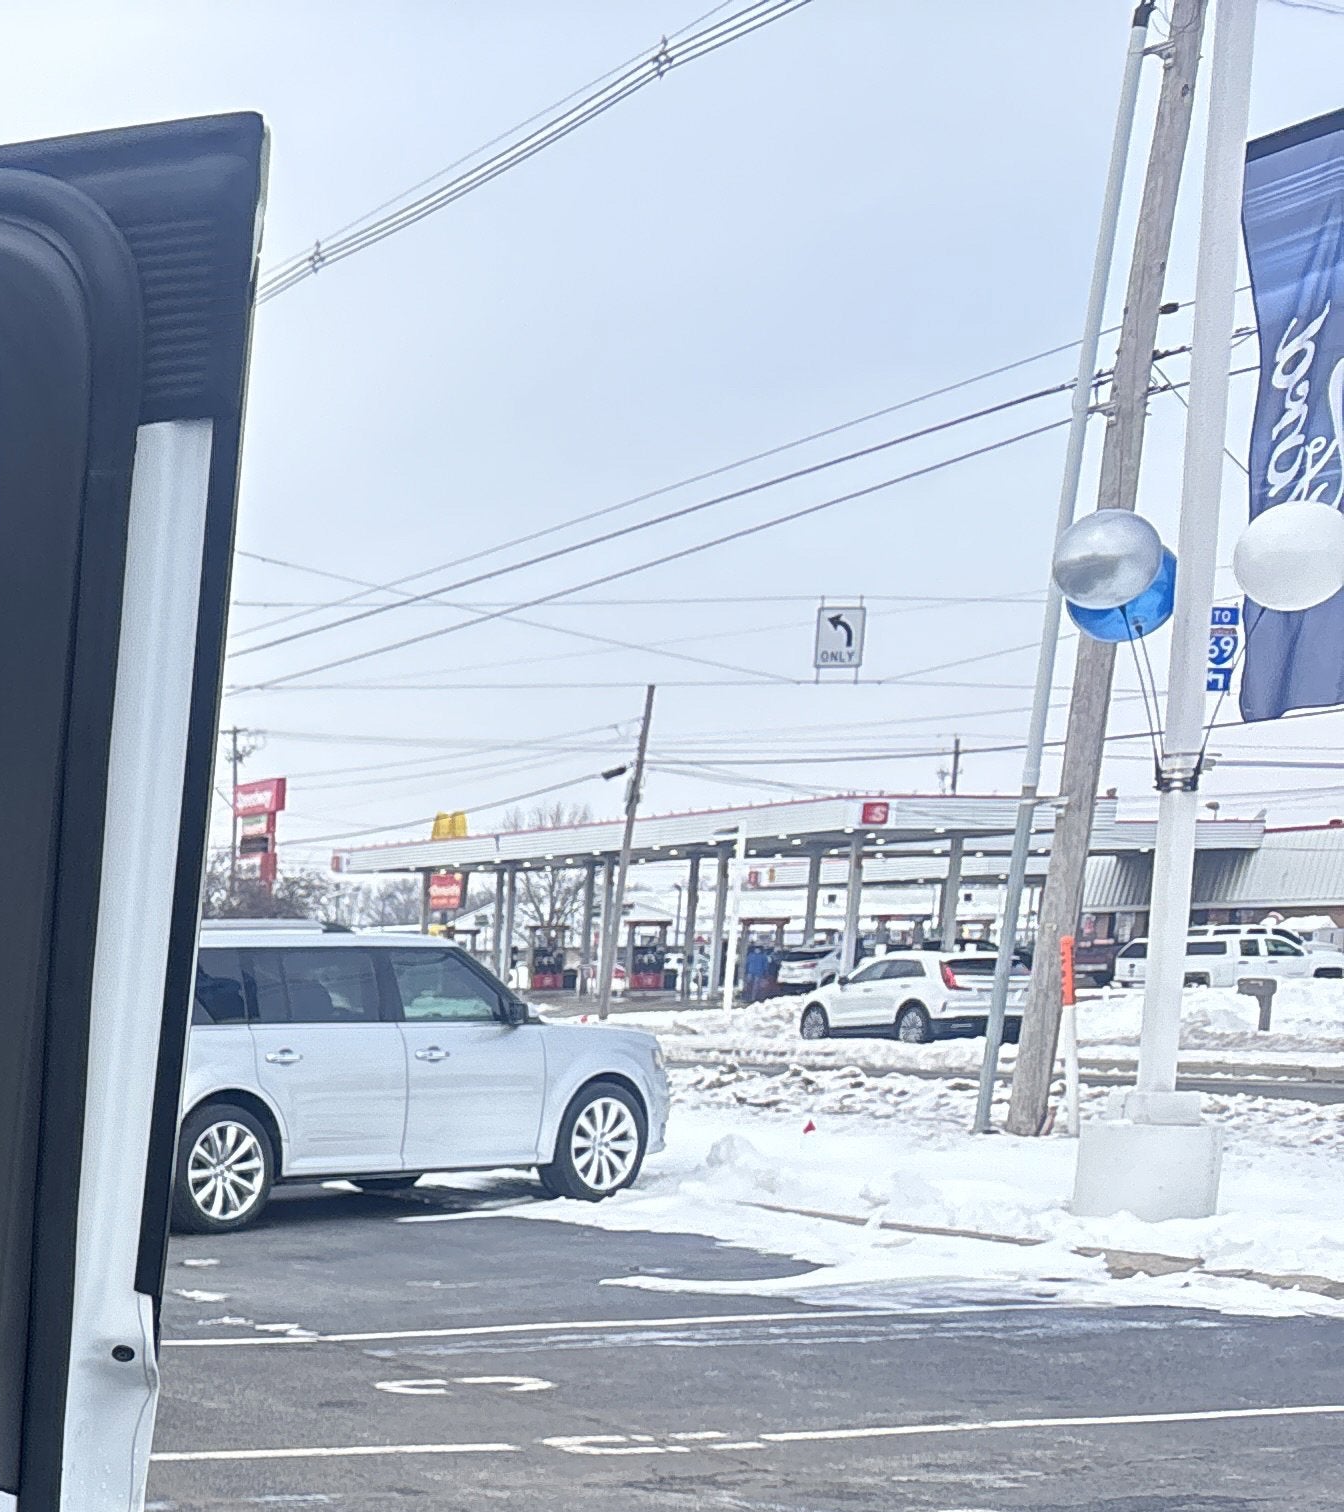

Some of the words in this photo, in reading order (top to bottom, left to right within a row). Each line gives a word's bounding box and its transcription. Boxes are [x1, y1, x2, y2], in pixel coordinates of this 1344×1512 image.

[1214, 610, 1232, 623] TO
[1208, 636, 1235, 659] 69
[820, 650, 855, 663] ONLY
